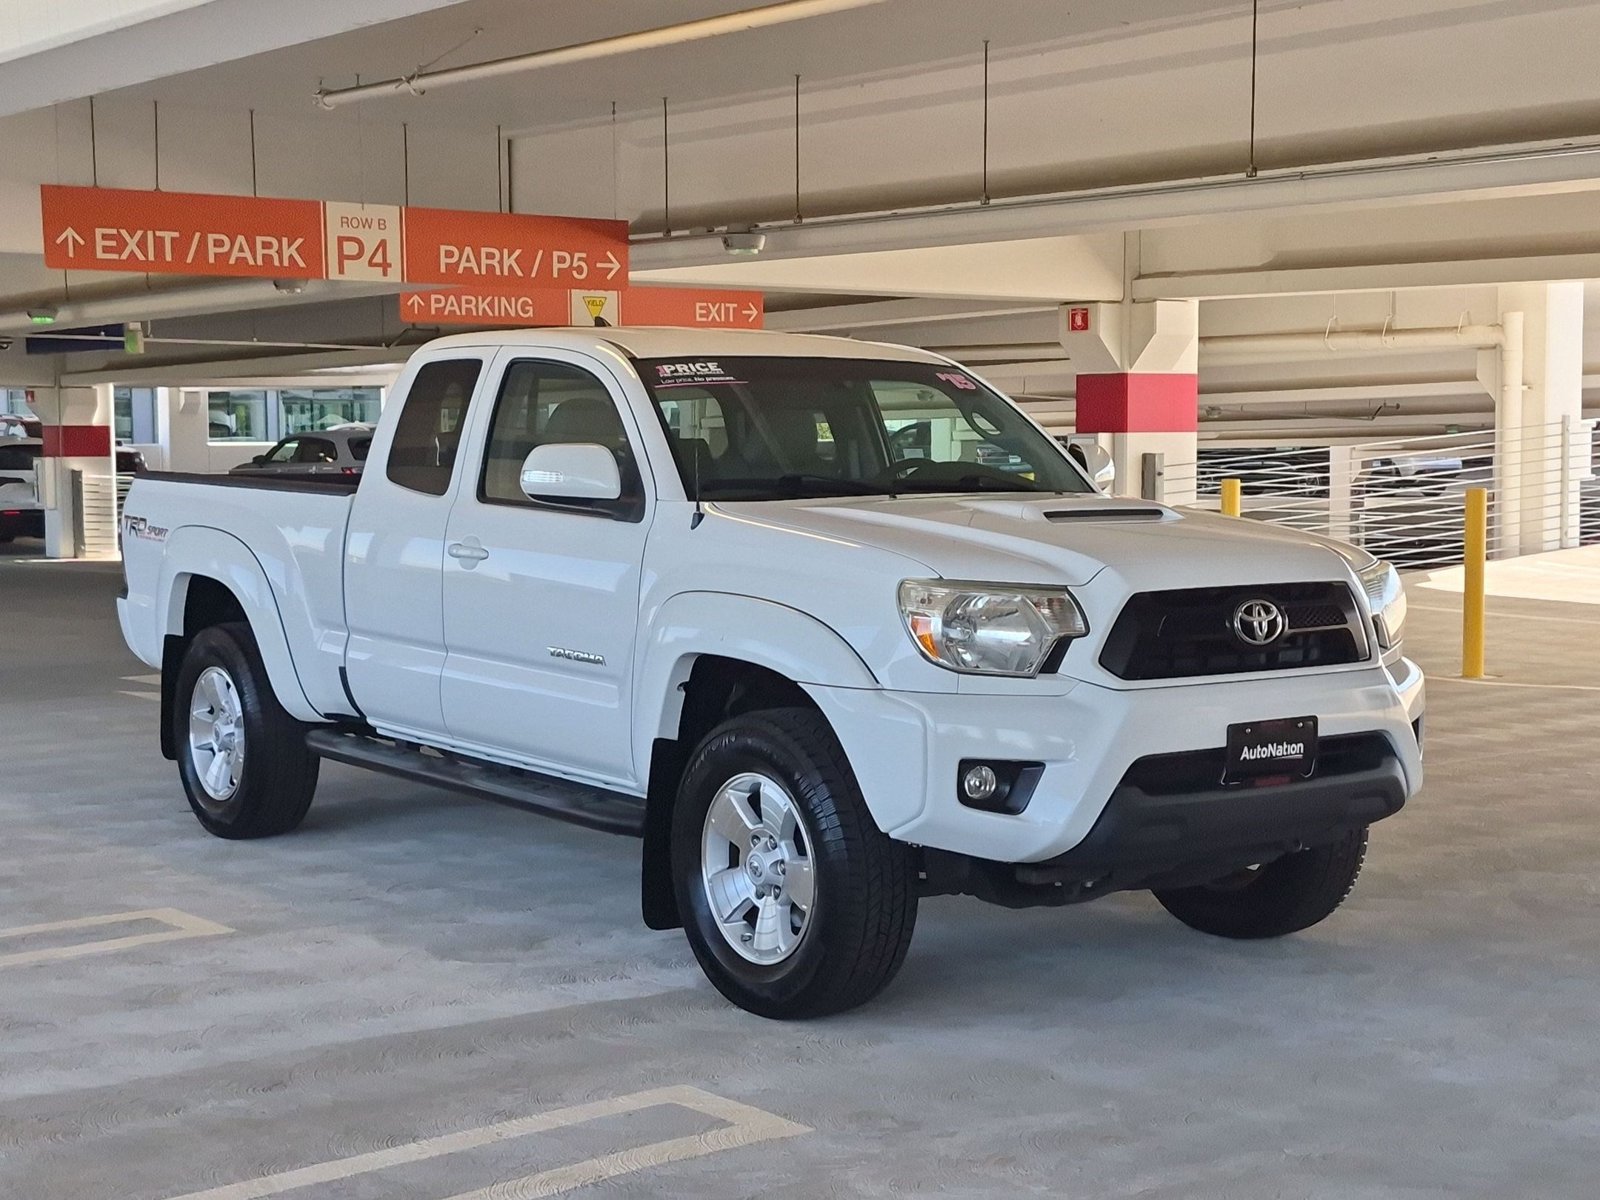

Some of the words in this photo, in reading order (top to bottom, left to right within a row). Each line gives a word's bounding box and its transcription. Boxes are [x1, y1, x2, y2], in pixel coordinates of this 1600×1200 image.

[340, 216, 376, 230] ROW
[378, 218, 387, 231] B
[95, 227, 180, 262] EXIT
[186, 232, 201, 264] /
[207, 233, 307, 268] PARK
[336, 235, 392, 277] P4
[439, 244, 524, 277] PARK
[530, 250, 544, 278] /
[552, 250, 588, 280] P5
[430, 294, 534, 318] PARKING
[587, 300, 604, 308] YIELD
[695, 302, 737, 322] EXIT
[124, 514, 148, 537] TRD
[1240, 741, 1304, 761] AutoNation
